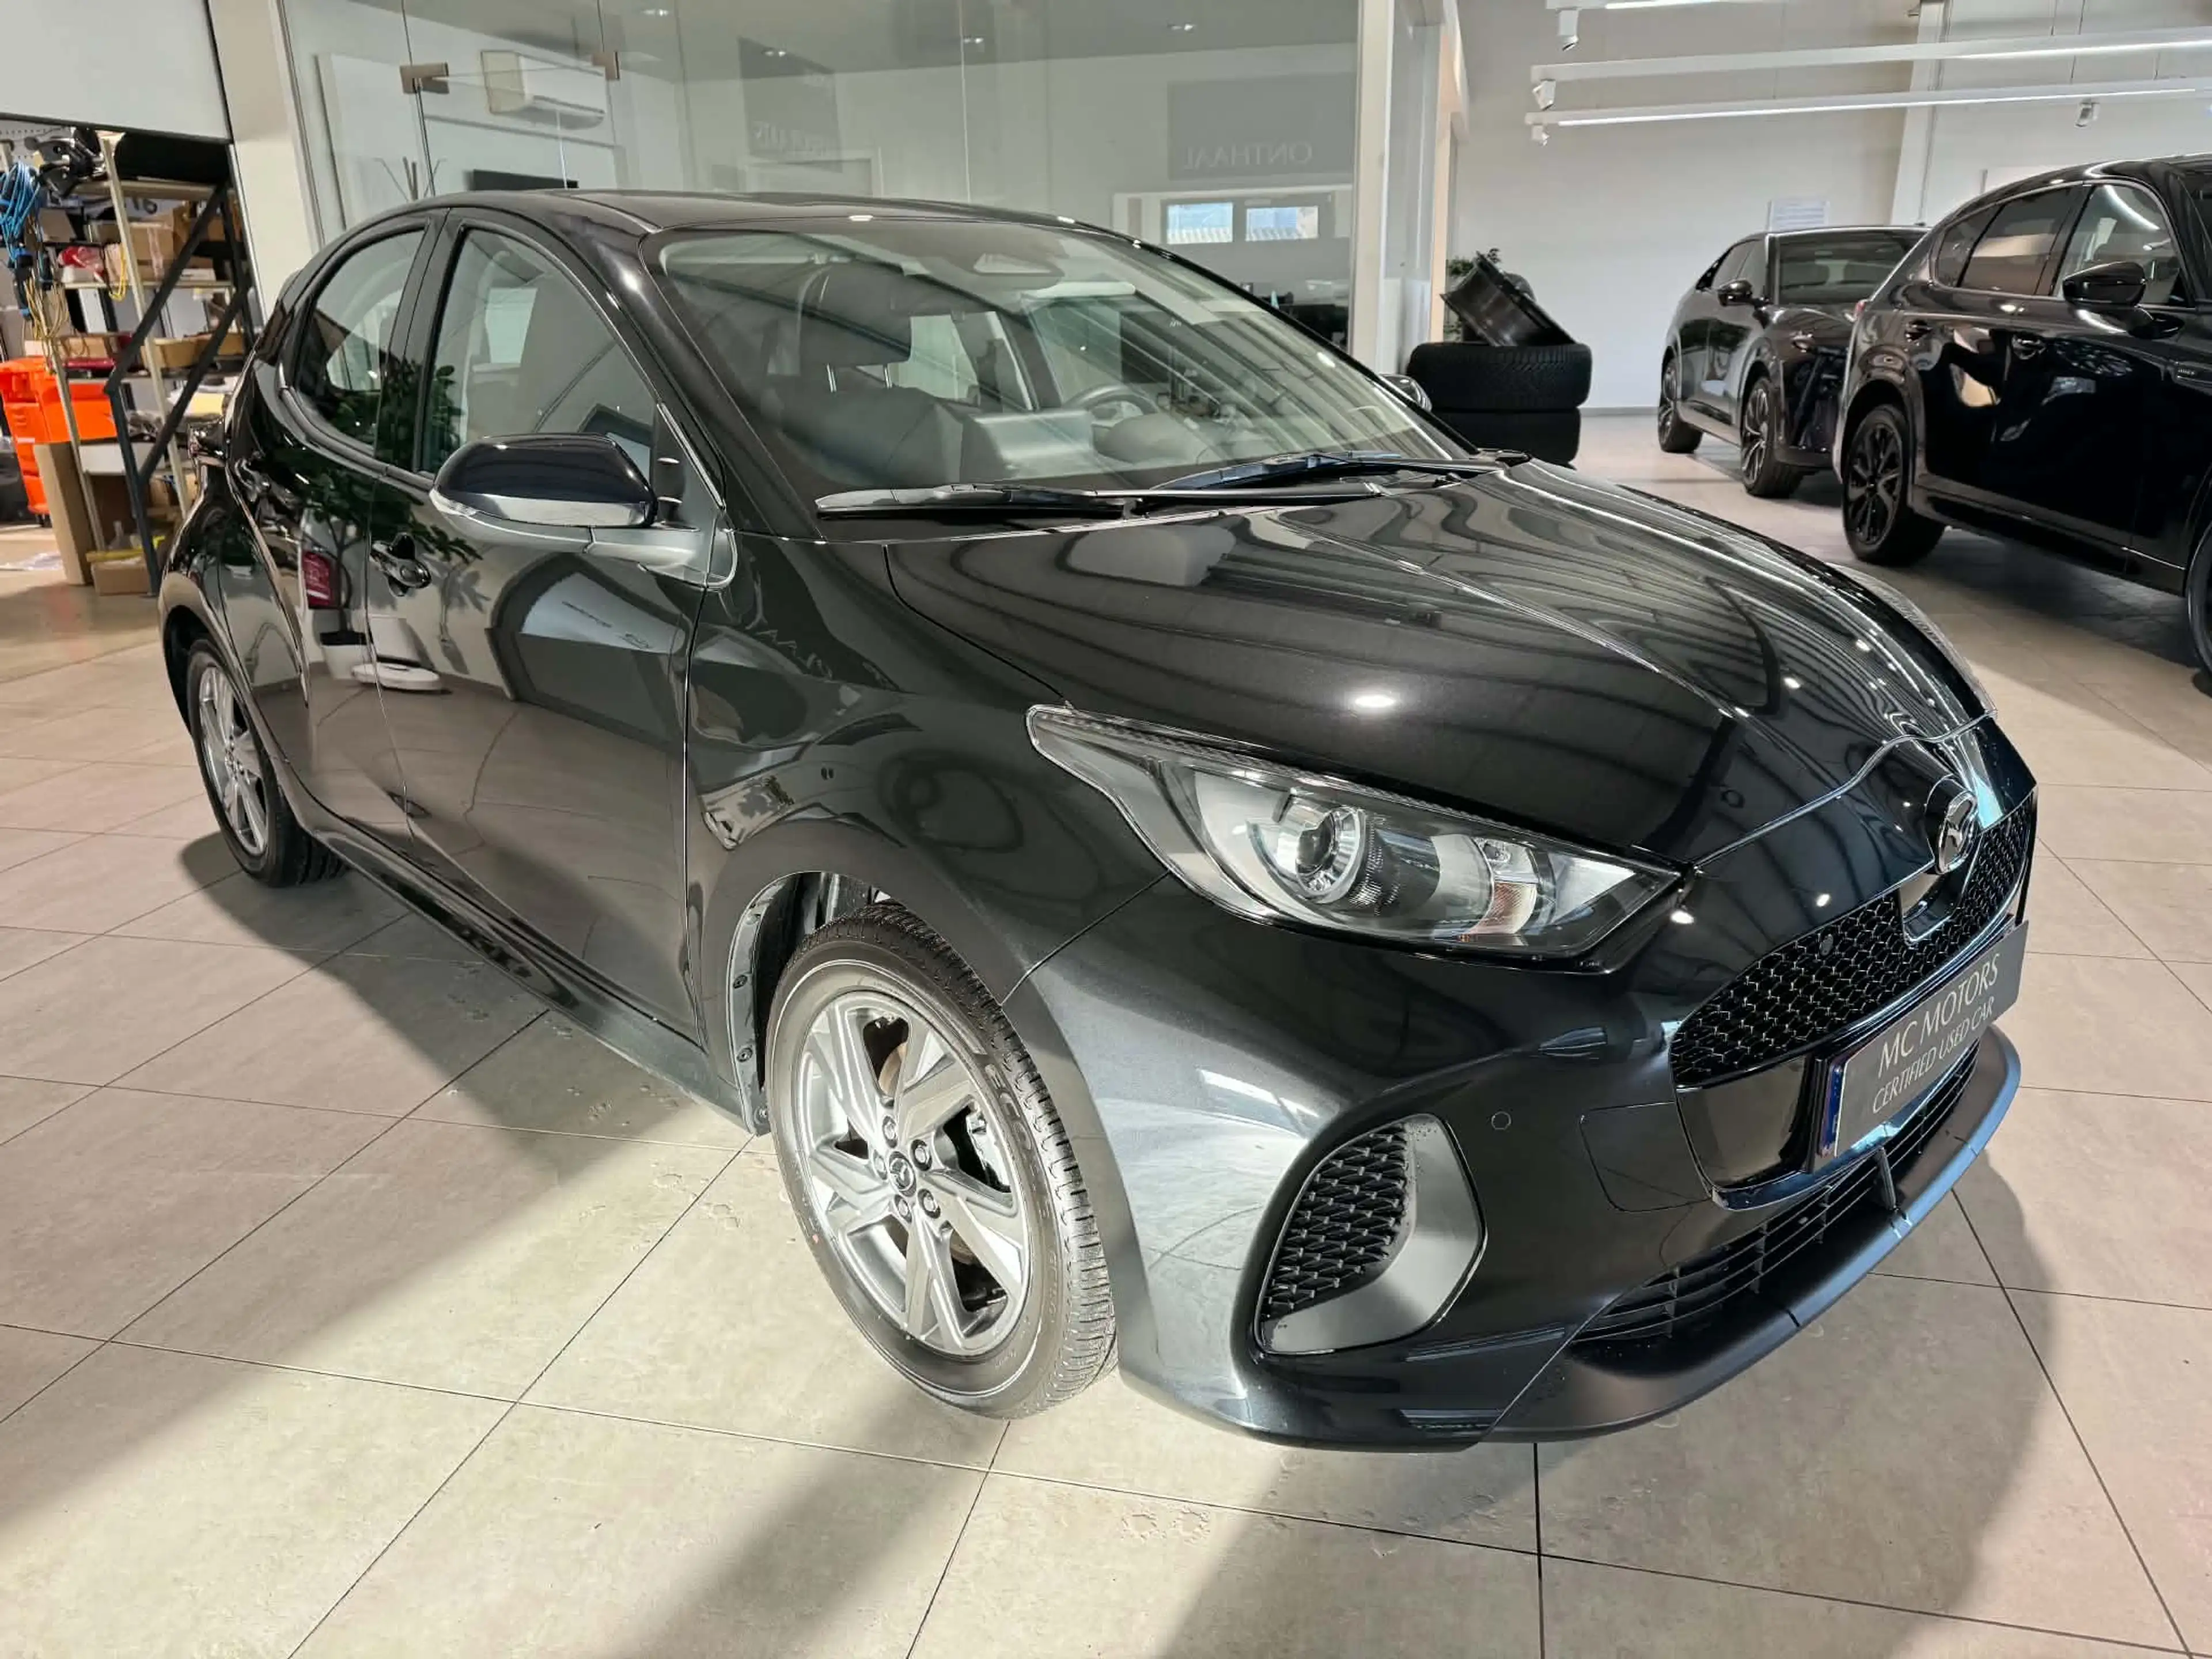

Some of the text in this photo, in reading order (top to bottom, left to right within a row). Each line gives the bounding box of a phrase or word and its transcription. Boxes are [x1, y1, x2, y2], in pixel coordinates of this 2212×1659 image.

[1873, 996, 1994, 1113] CERTIFIED USED CAR
[1878, 953, 1999, 1078] MC MOTORS
